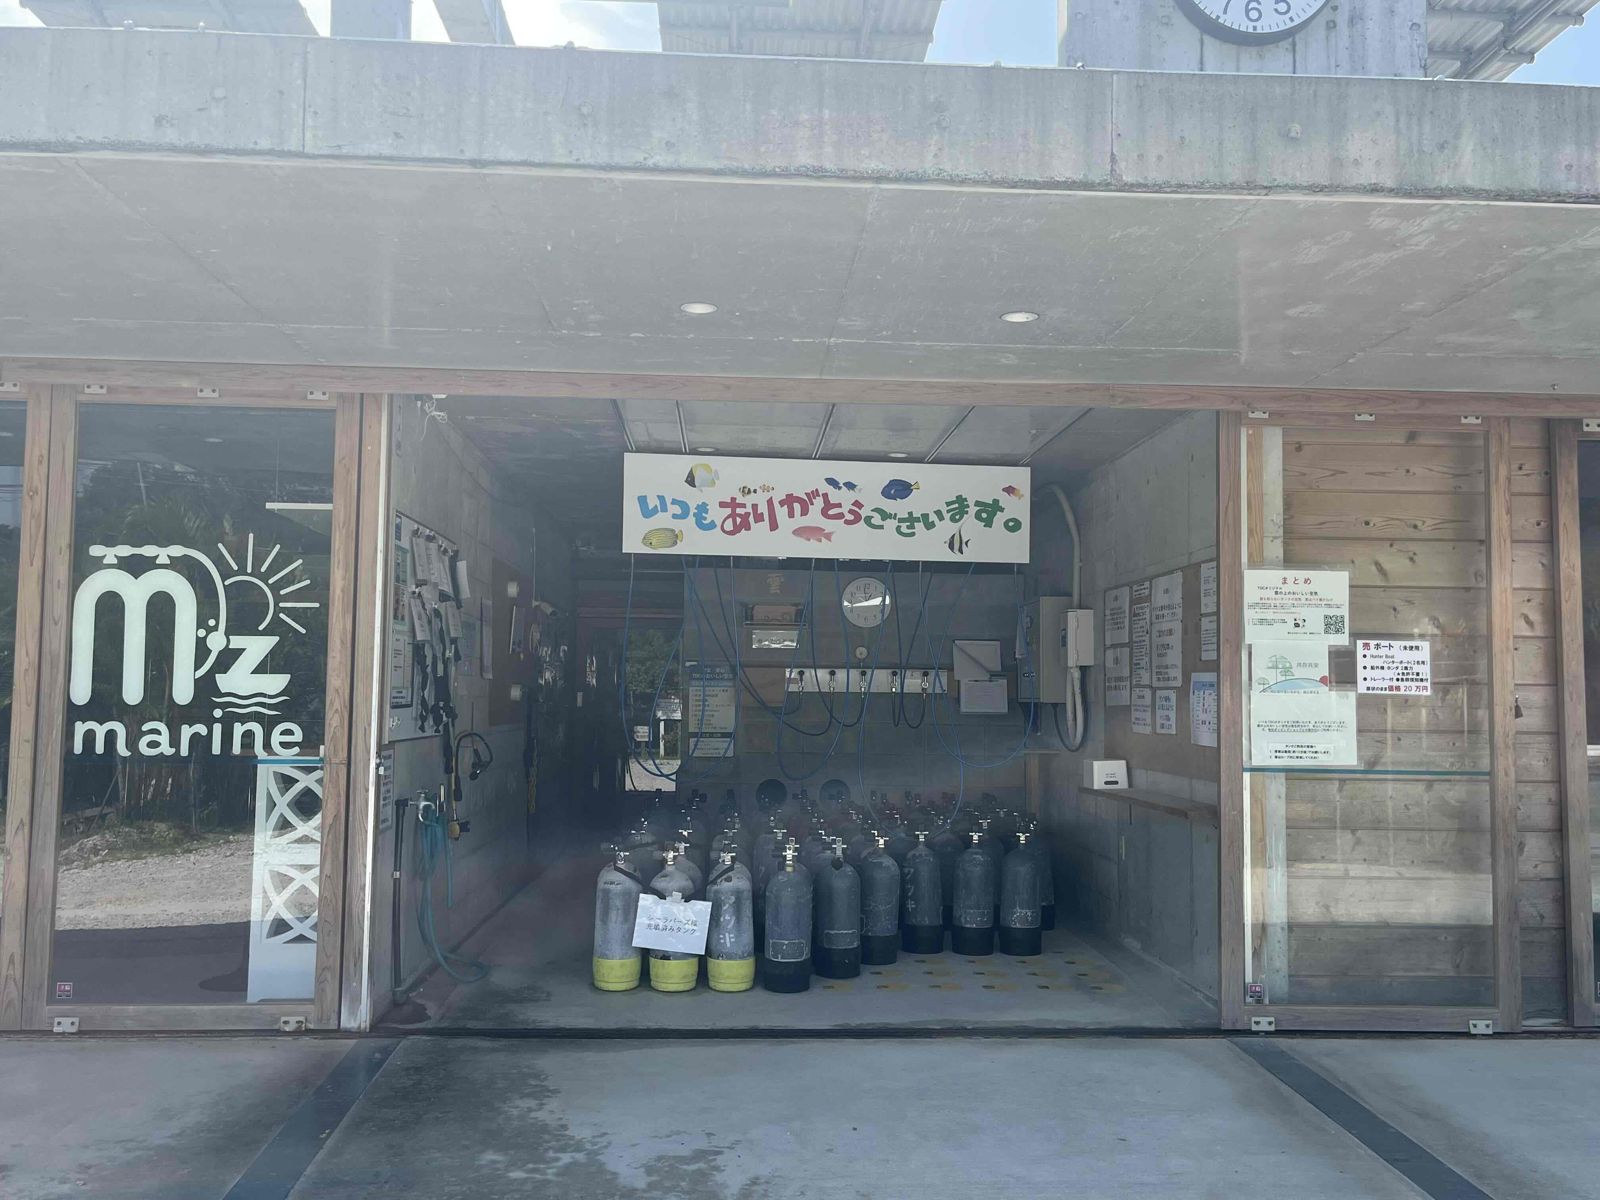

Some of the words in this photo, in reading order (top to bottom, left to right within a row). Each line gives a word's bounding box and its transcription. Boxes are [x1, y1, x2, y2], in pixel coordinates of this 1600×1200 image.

[1245, 0, 1262, 22] 6
[1281, 577, 1312, 585] まとめ
[1362, 642, 1371, 651] 売
[1374, 642, 1394, 651] ボート
[73, 708, 303, 757] marine
